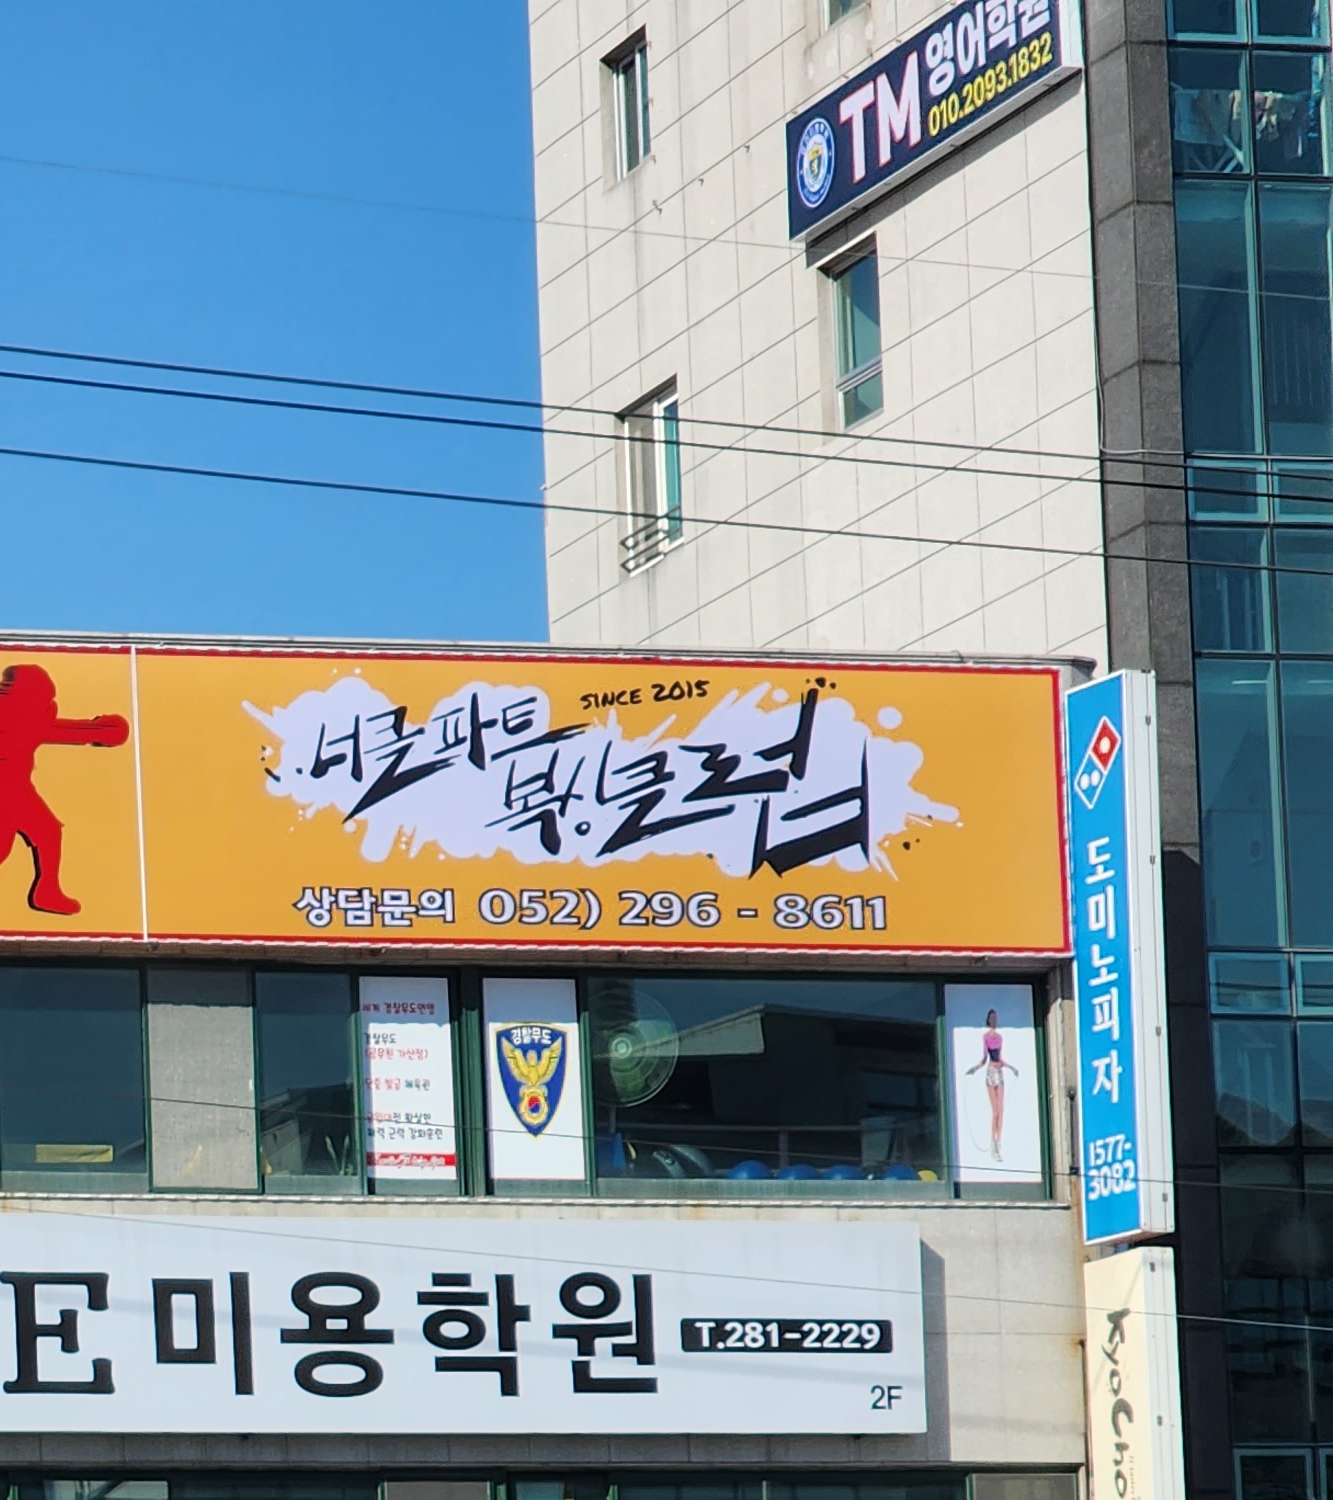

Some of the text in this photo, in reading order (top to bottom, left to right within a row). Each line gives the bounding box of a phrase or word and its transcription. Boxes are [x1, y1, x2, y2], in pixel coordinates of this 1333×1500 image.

[928, 31, 1053, 137] 010.2093.1832
[839, 51, 923, 184] TM
[580, 679, 710, 711] SINCE 2015
[294, 886, 456, 929] 상담문의
[478, 888, 602, 931] 052)
[617, 891, 722, 928] 296
[772, 892, 888, 931] 8611
[1085, 835, 1124, 1104] 도미노피자
[1088, 1160, 1137, 1201] 3082
[150, 1268, 660, 1399] 미용학원
[693, 1319, 884, 1353] T.281-2229
[869, 1385, 902, 1411] 2F
